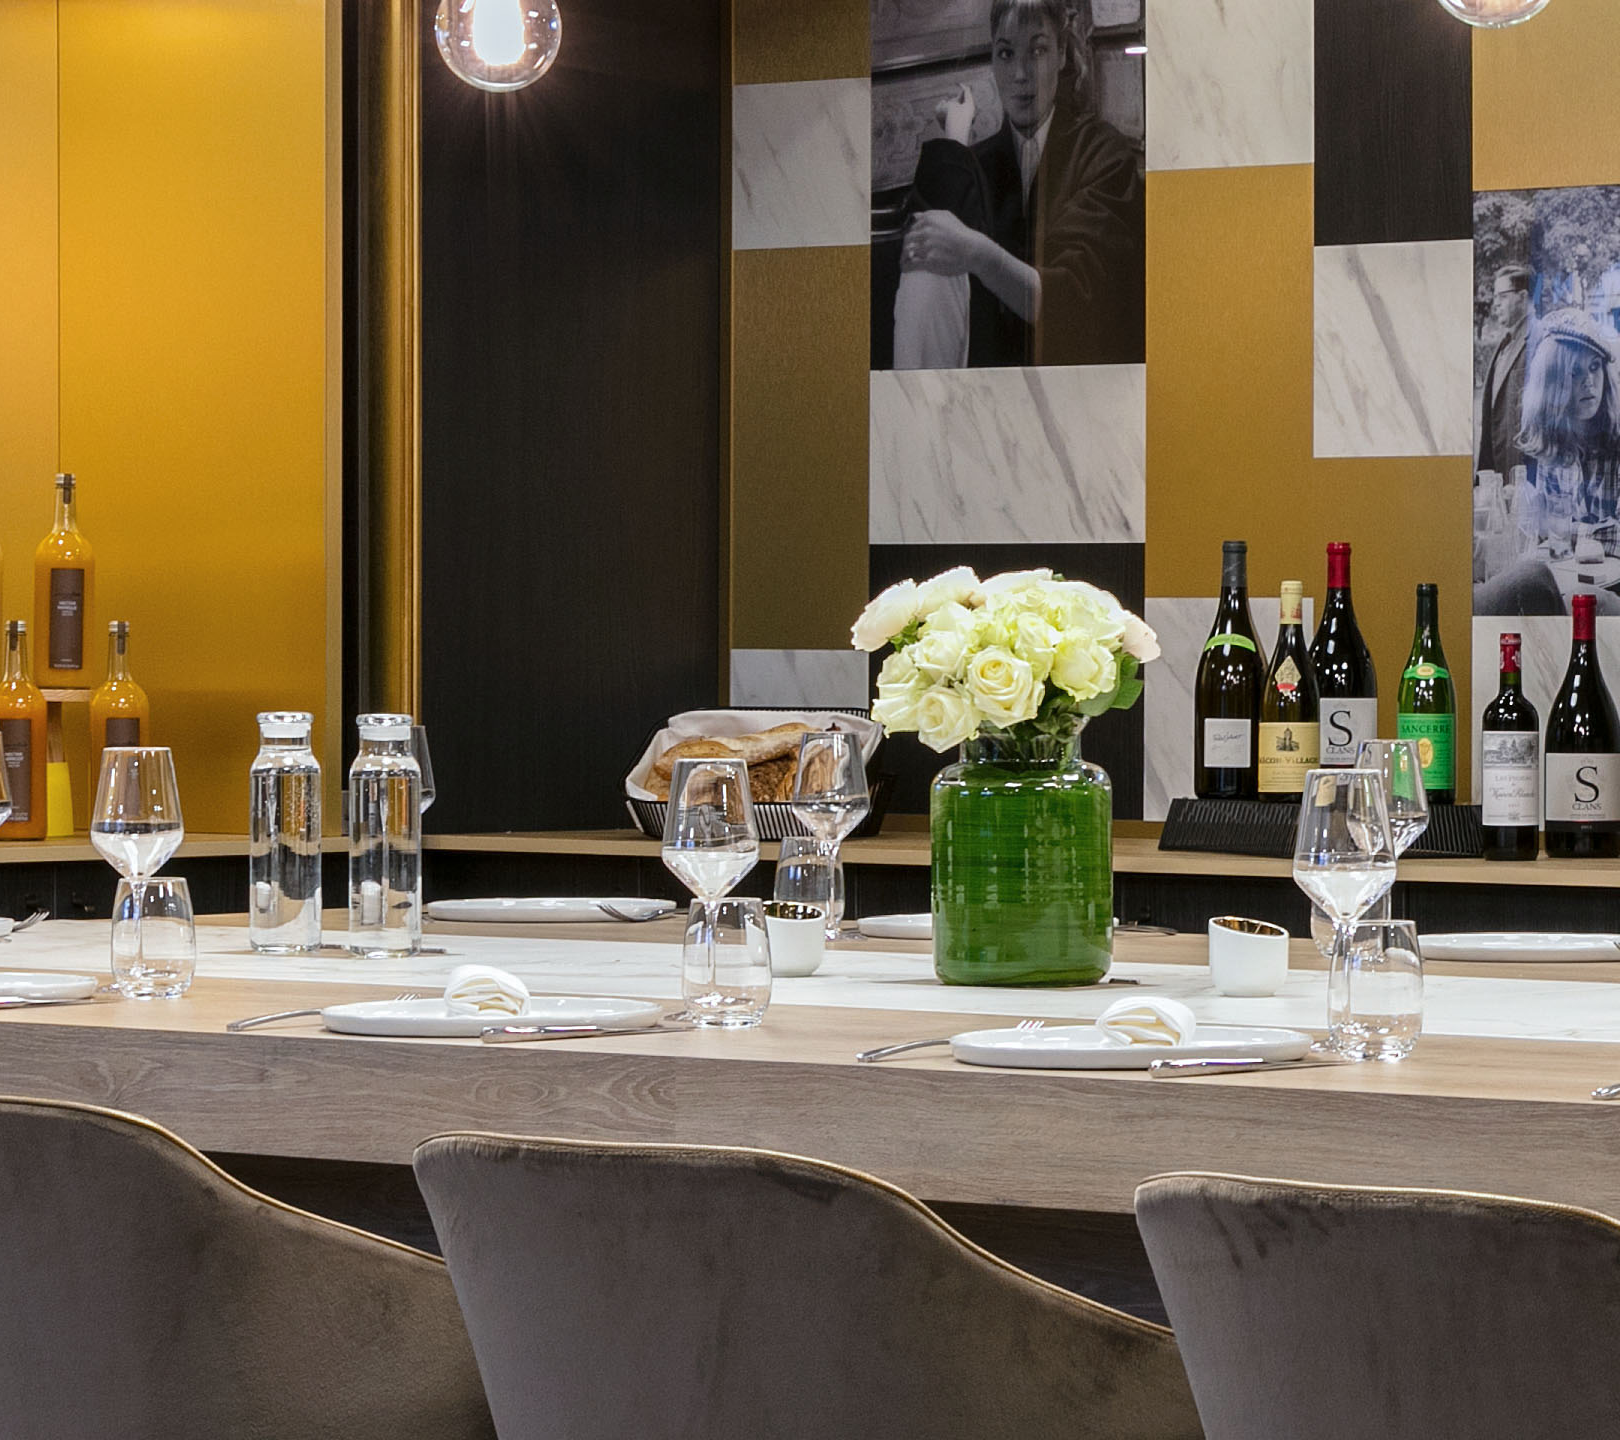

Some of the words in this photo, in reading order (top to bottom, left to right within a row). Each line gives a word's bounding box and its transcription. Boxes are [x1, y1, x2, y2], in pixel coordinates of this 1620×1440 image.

[1328, 710, 1353, 747] S
[1401, 724, 1451, 734] SANCERRE
[1574, 766, 1600, 803] S
